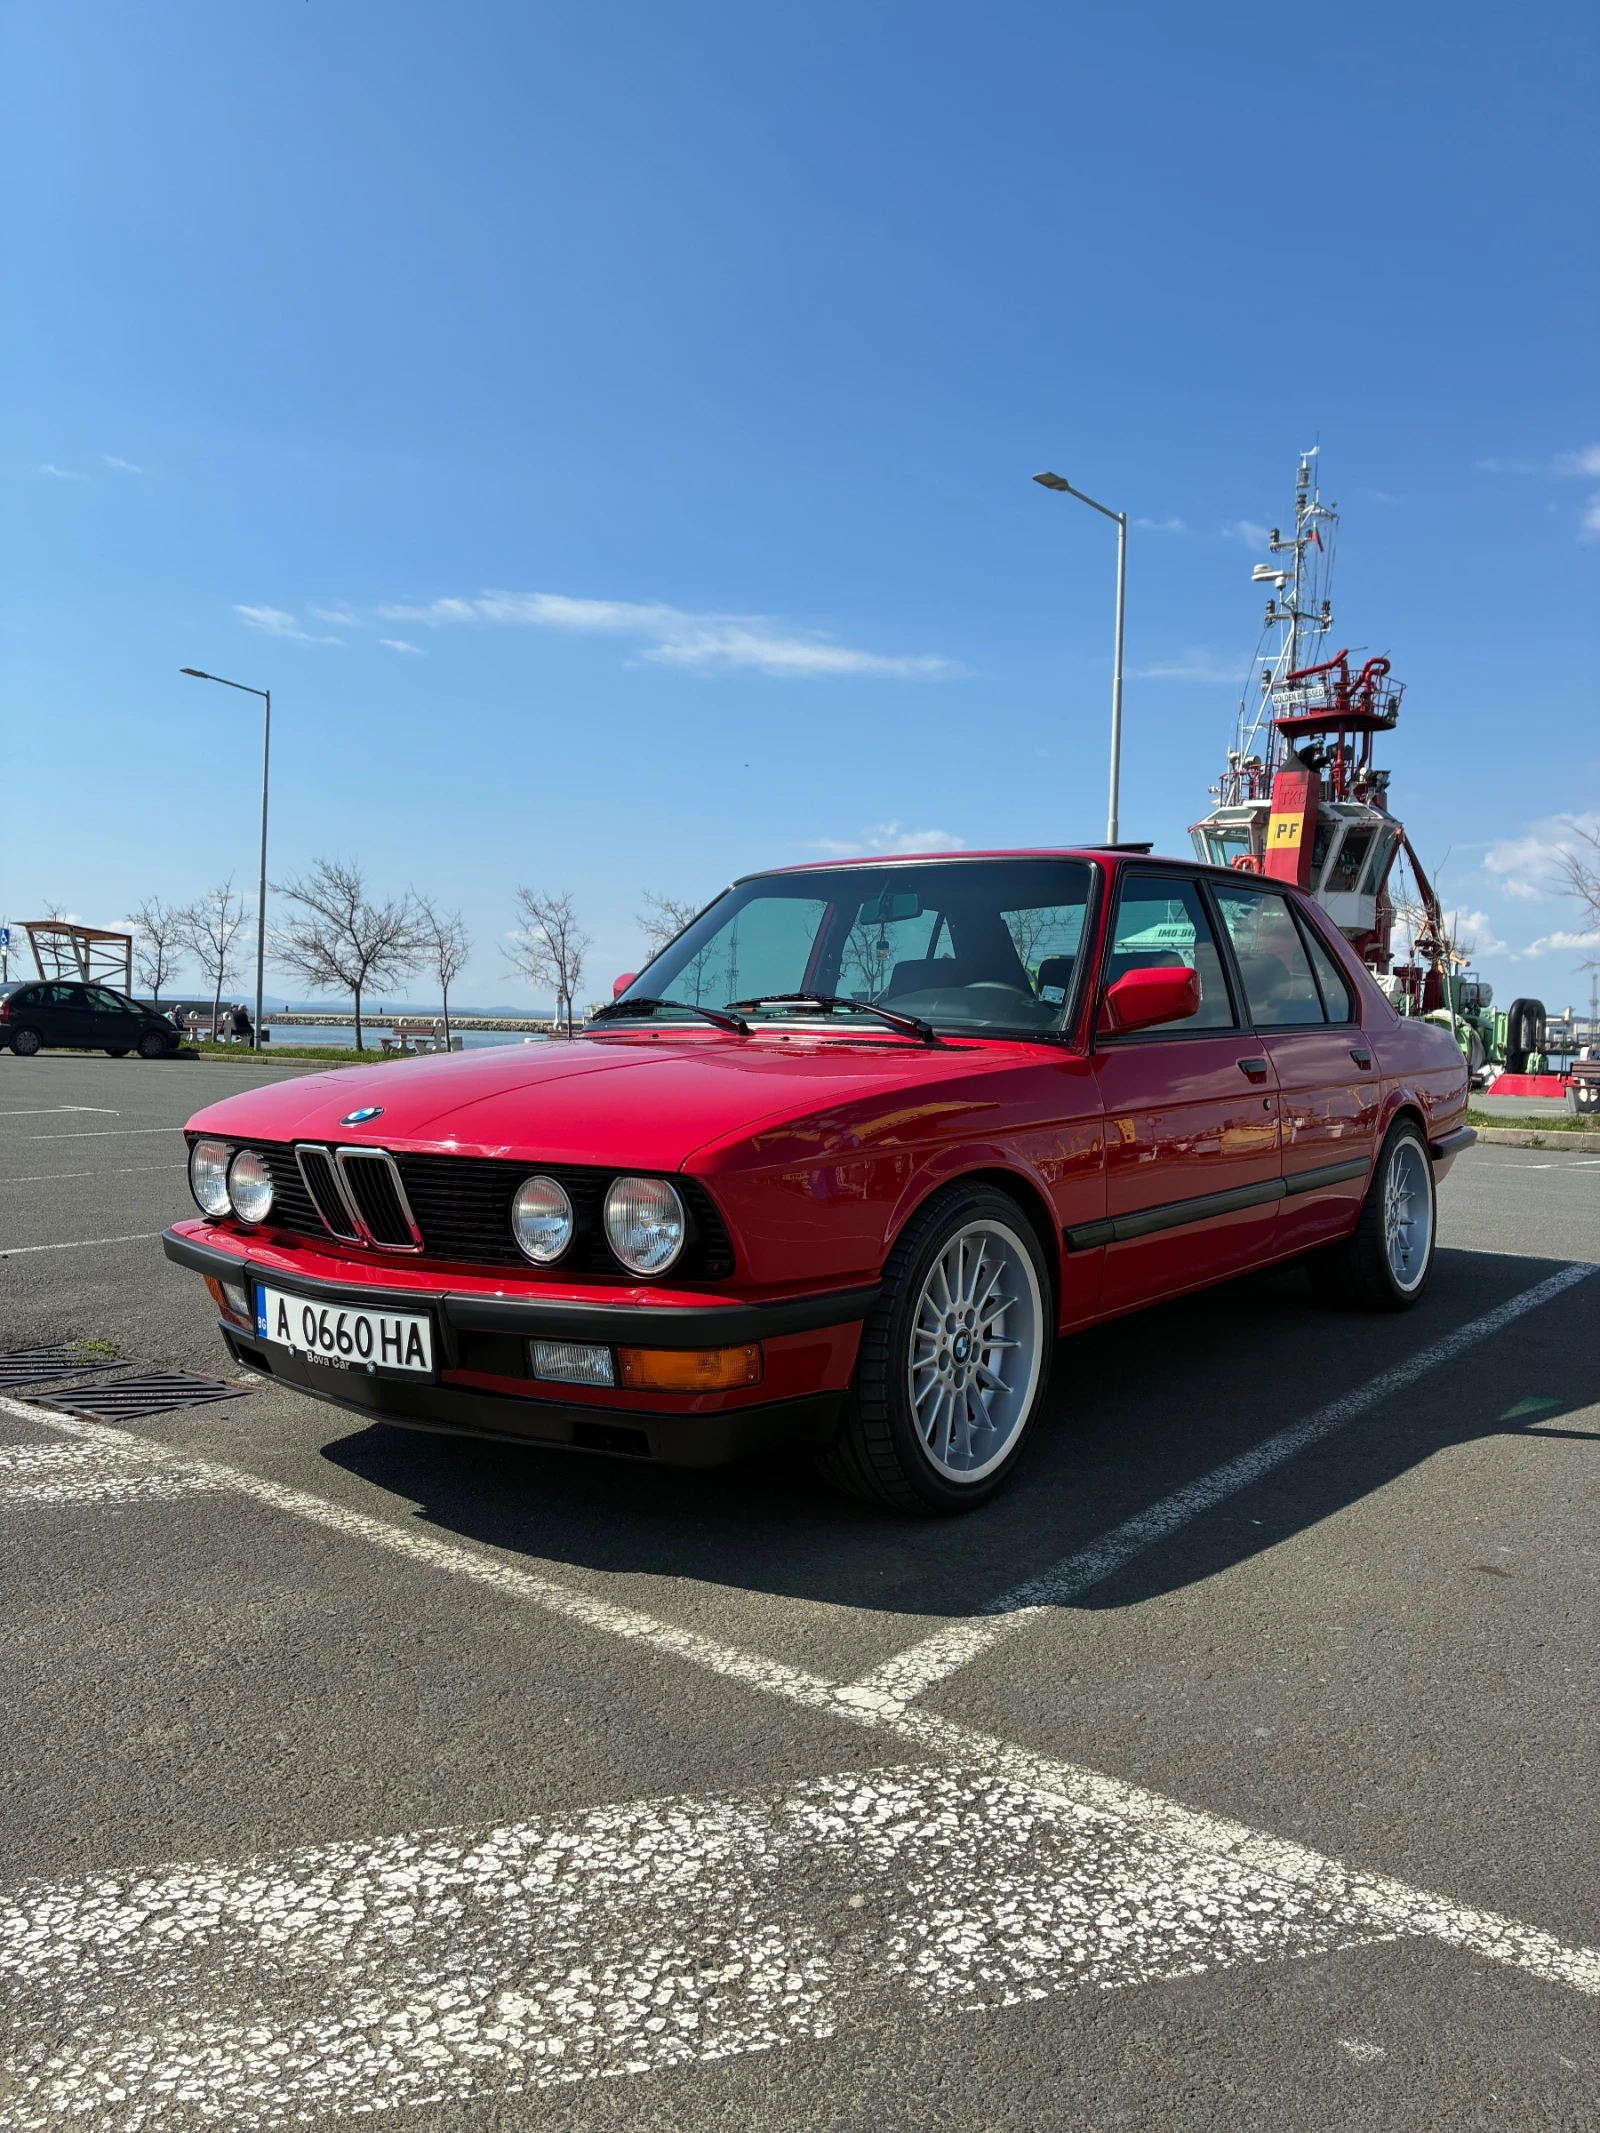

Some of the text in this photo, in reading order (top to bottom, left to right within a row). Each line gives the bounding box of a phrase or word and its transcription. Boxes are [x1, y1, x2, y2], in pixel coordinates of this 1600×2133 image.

[1273, 688, 1323, 704] GOLDEN BLESSED
[1276, 822, 1299, 839] PF
[257, 1316, 267, 1330] BG
[277, 1297, 291, 1341] A
[306, 1351, 350, 1371] Bova Car
